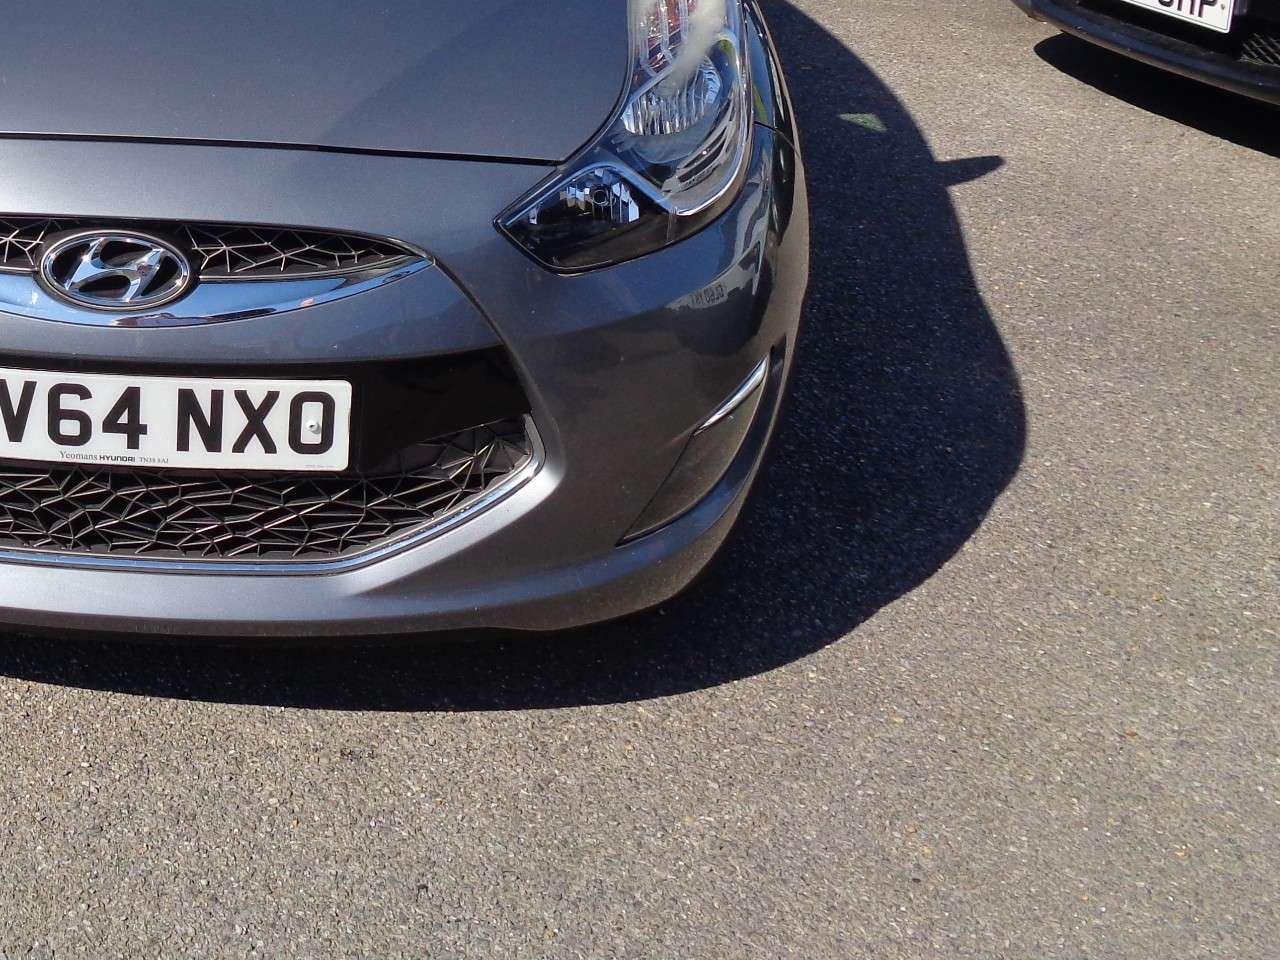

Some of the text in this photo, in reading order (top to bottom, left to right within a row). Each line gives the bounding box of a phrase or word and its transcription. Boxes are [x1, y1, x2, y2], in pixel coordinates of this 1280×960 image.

[176, 387, 336, 456] NXO
[59, 451, 98, 461] Yeomans
[99, 455, 135, 463] HYUNDAI
